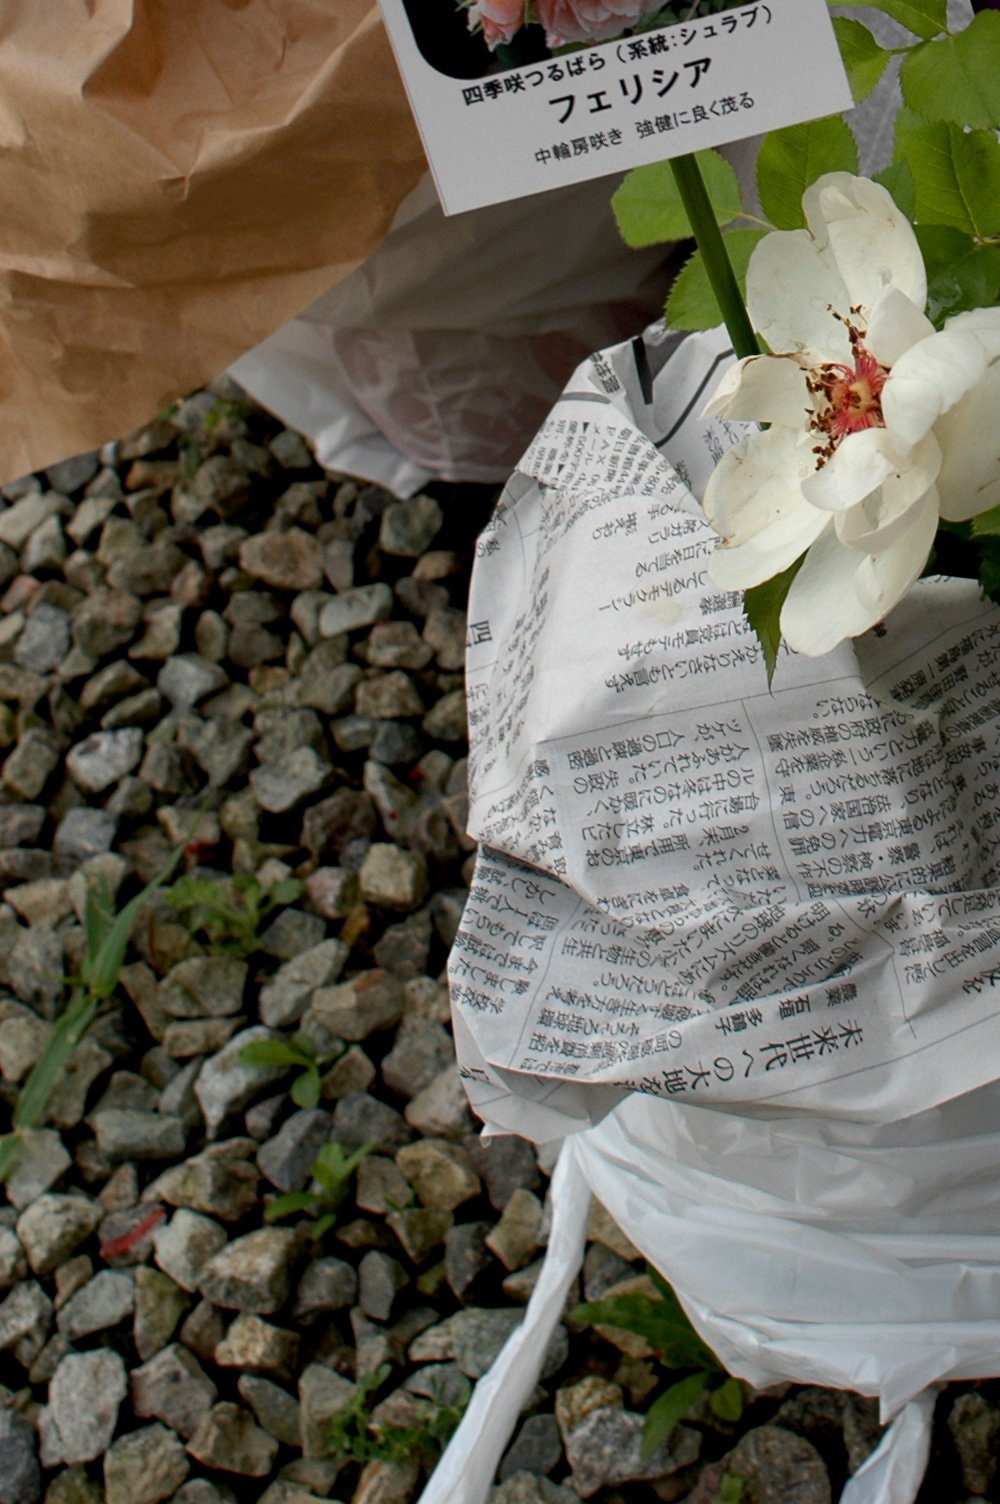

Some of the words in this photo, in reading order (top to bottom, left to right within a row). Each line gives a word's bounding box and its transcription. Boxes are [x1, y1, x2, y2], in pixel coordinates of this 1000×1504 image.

[548, 56, 713, 125] フェリシア
[534, 127, 624, 166] 中輪房咲き
[634, 90, 756, 140] 強健に良く茂る
